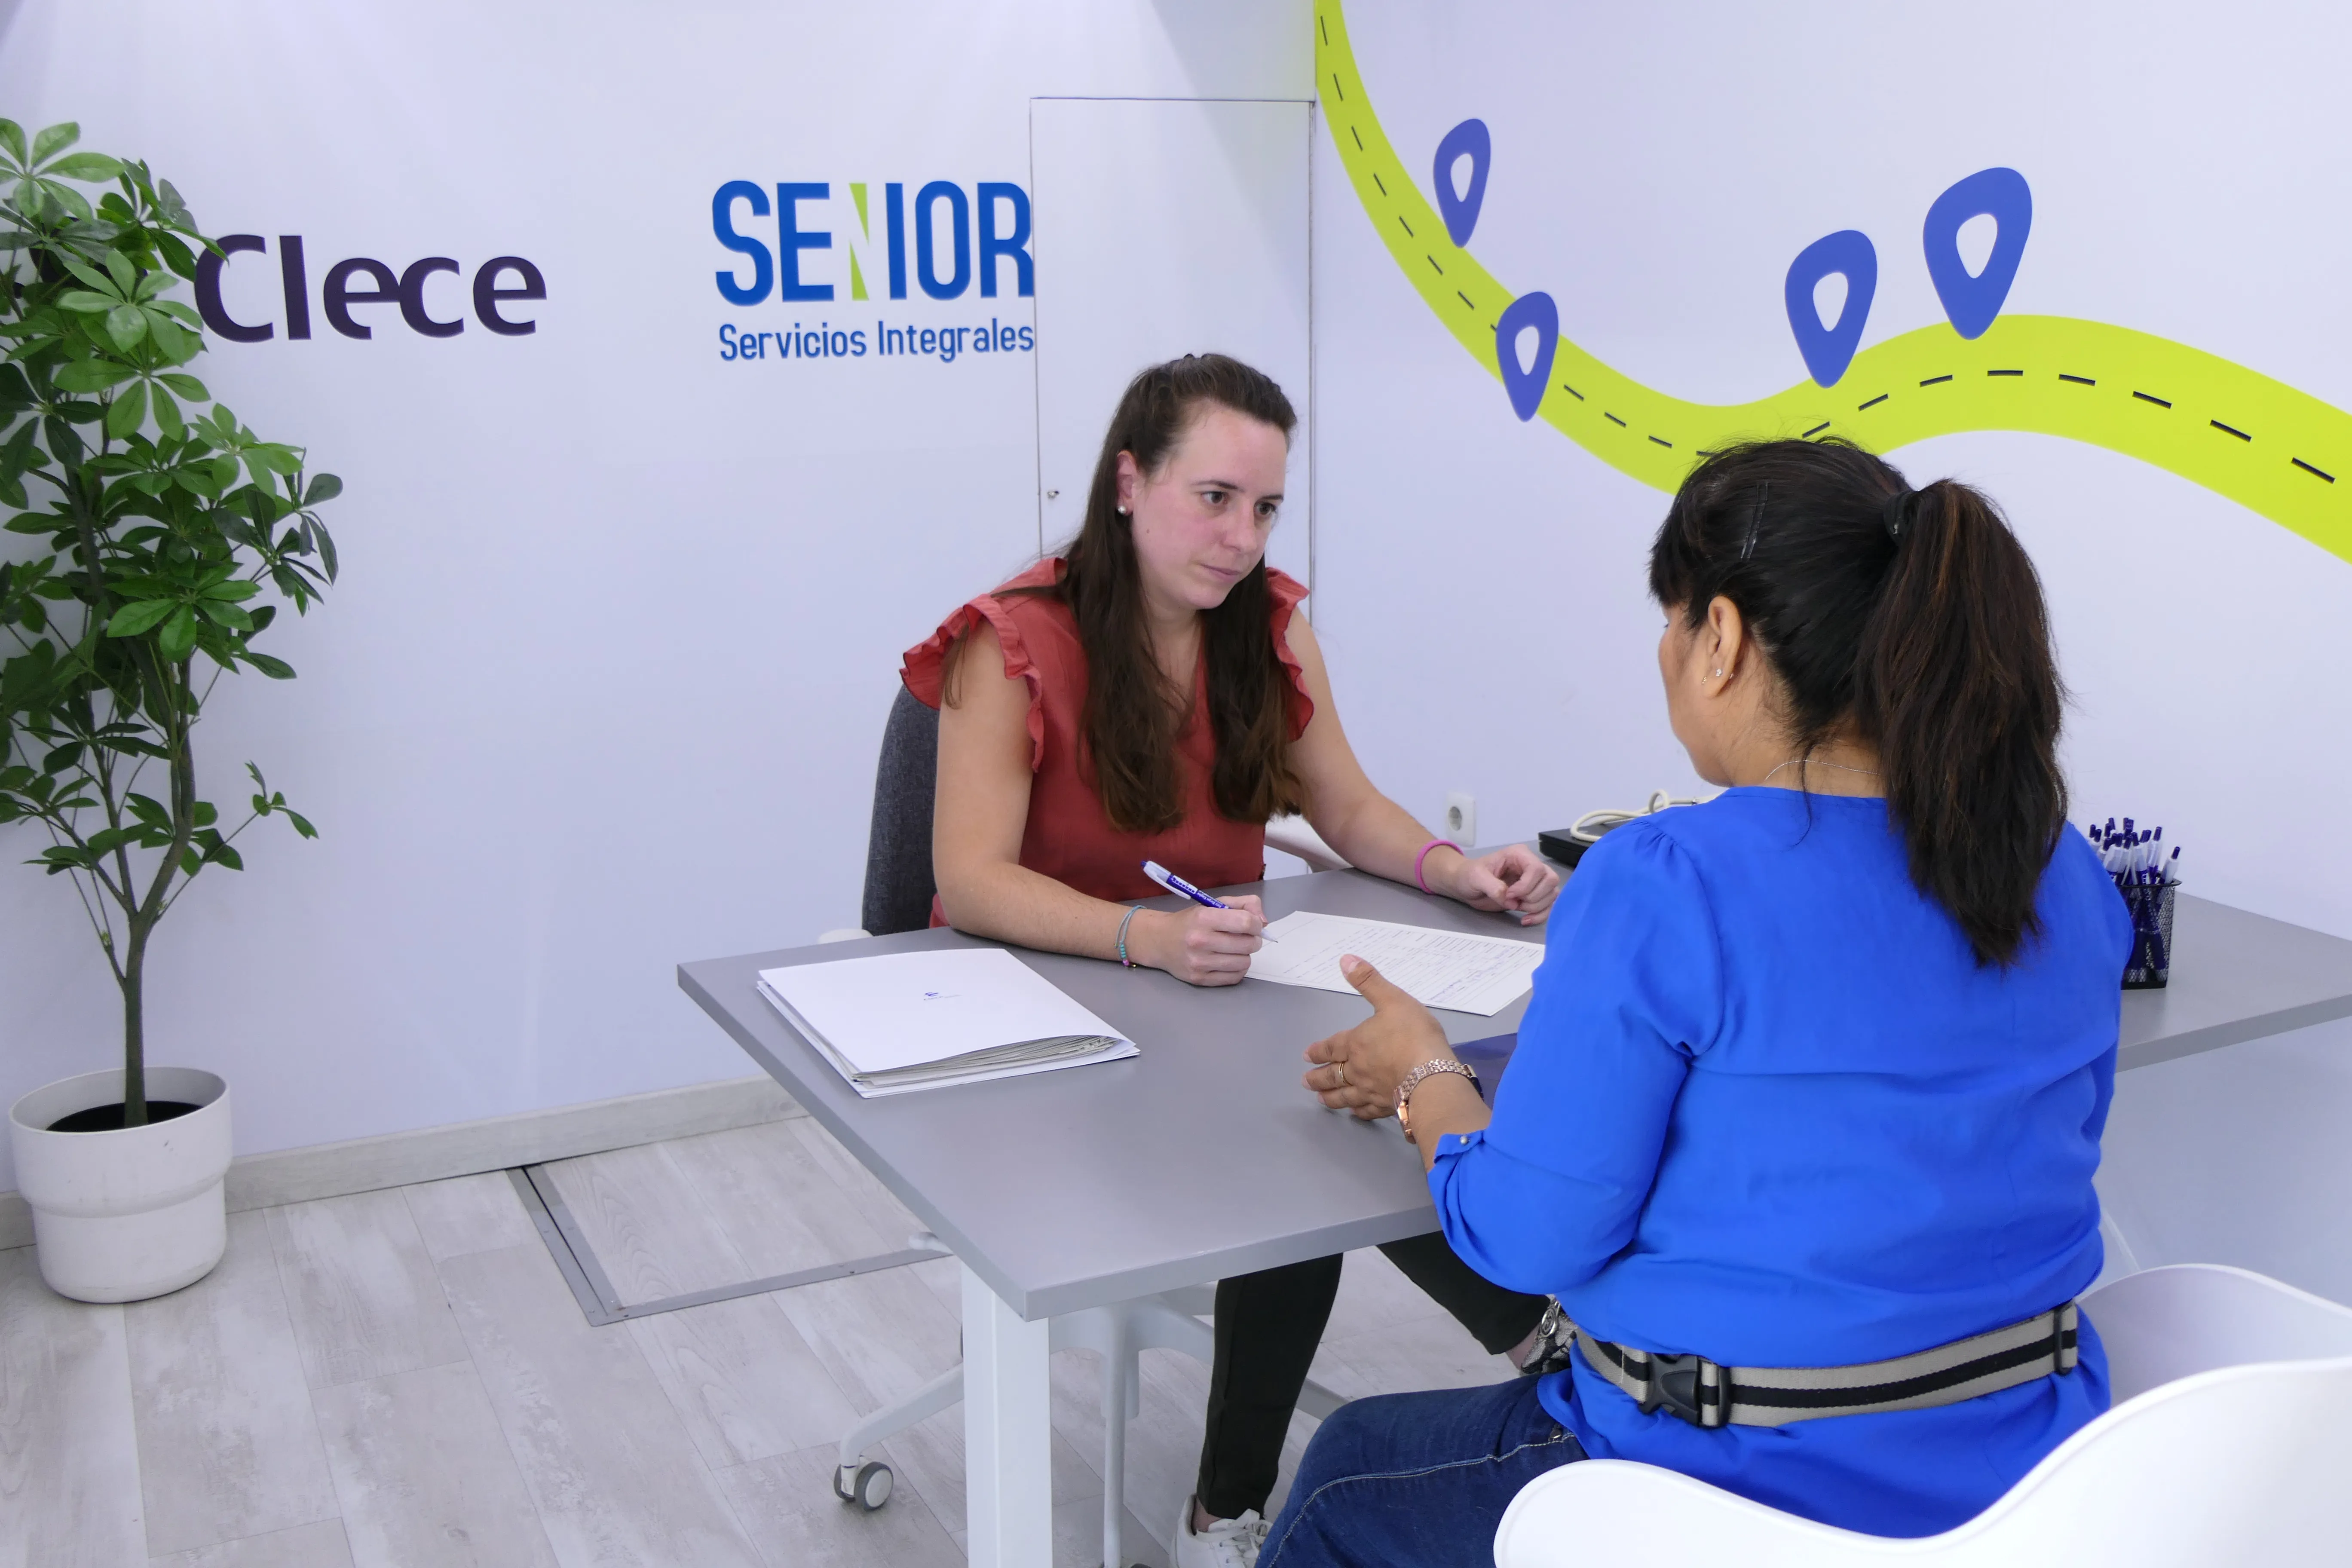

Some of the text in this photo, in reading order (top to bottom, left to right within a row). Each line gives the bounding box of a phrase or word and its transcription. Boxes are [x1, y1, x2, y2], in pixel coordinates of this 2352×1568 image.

[194, 234, 548, 343] Clece
[712, 180, 1035, 306] SENIOR
[719, 318, 1034, 363] Servicios Integrales
